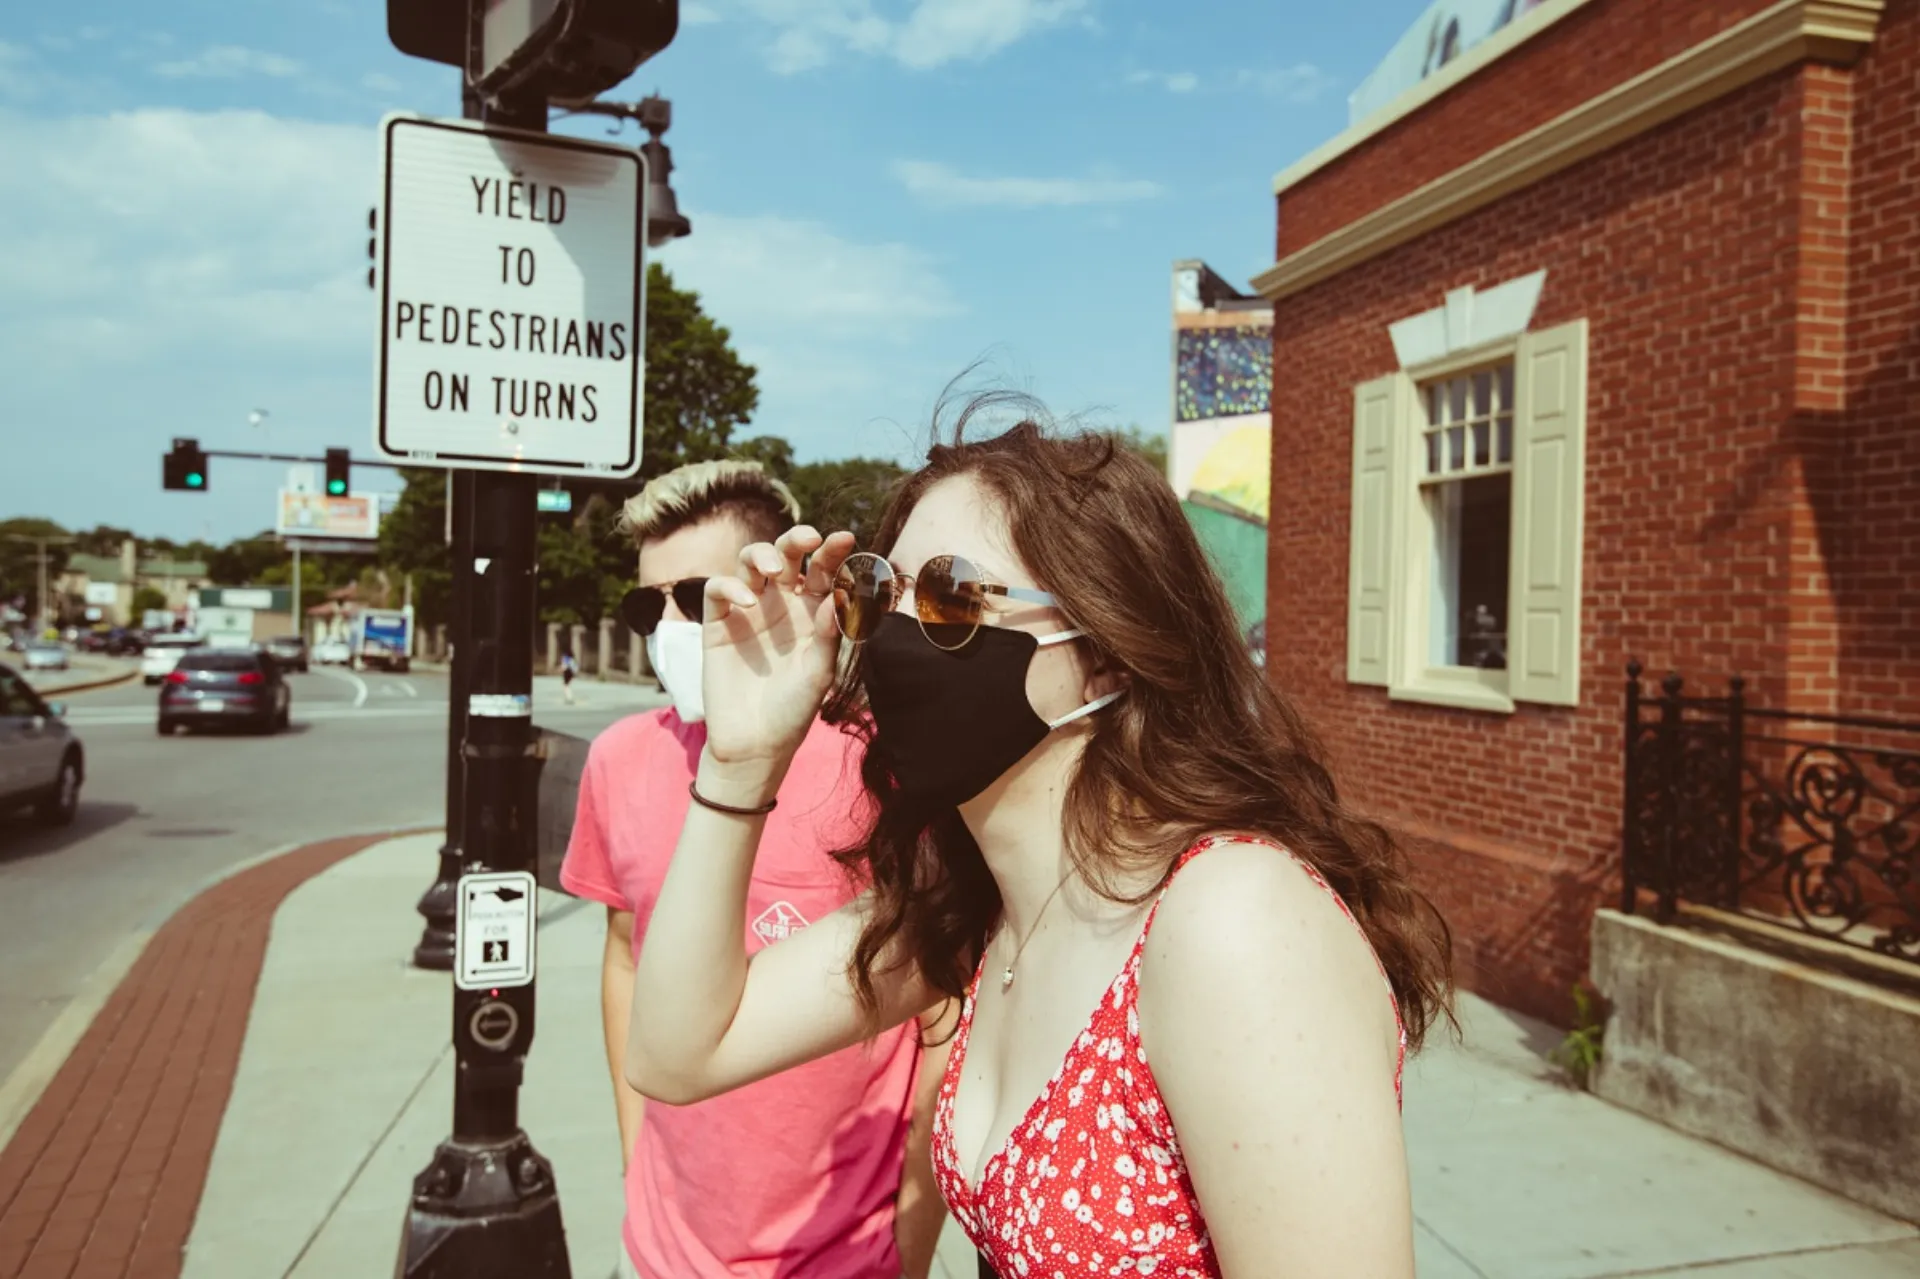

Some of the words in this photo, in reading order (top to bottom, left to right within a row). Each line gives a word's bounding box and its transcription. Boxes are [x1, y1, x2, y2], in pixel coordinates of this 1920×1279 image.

[471, 175, 567, 225] YIELD
[498, 245, 537, 287] TO
[396, 300, 628, 362] PEDESTRIANS
[424, 370, 470, 412] ON
[491, 377, 599, 423] TURNS
[483, 924, 509, 936] FOR
